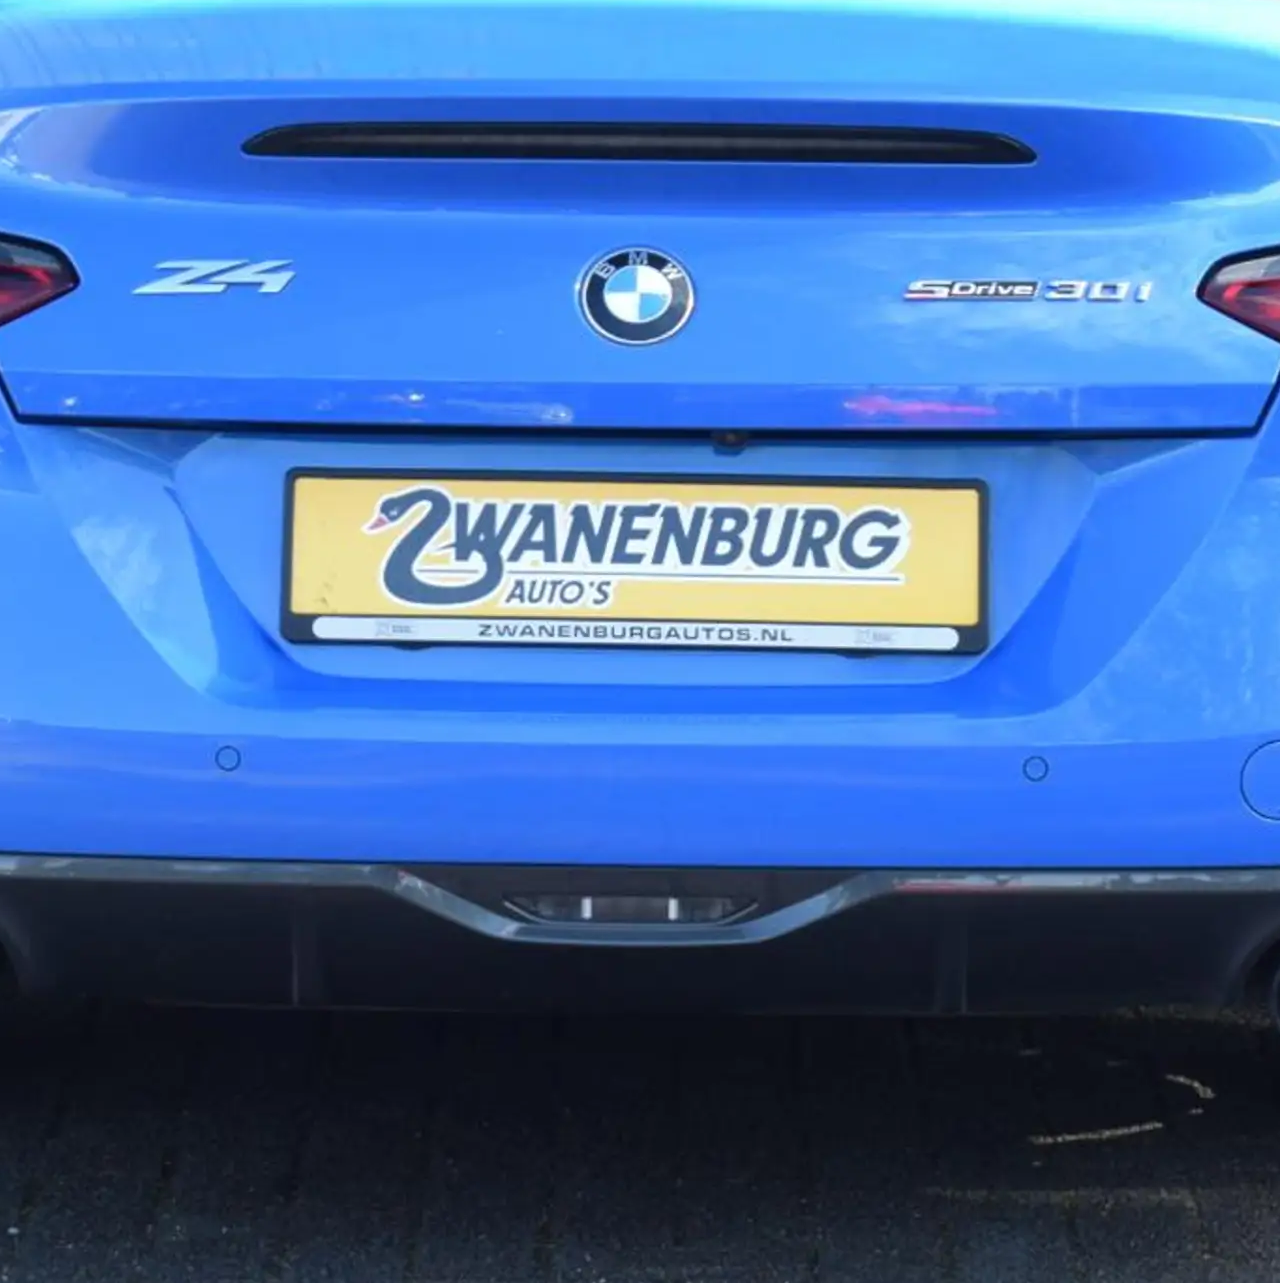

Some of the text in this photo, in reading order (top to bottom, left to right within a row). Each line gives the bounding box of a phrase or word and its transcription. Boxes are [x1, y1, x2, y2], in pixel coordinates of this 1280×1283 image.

[131, 258, 297, 295] Z4
[594, 251, 683, 281] BMW
[504, 578, 612, 608] AUTO'S
[478, 623, 794, 643] ZWANENBURGAUTOS.NL
